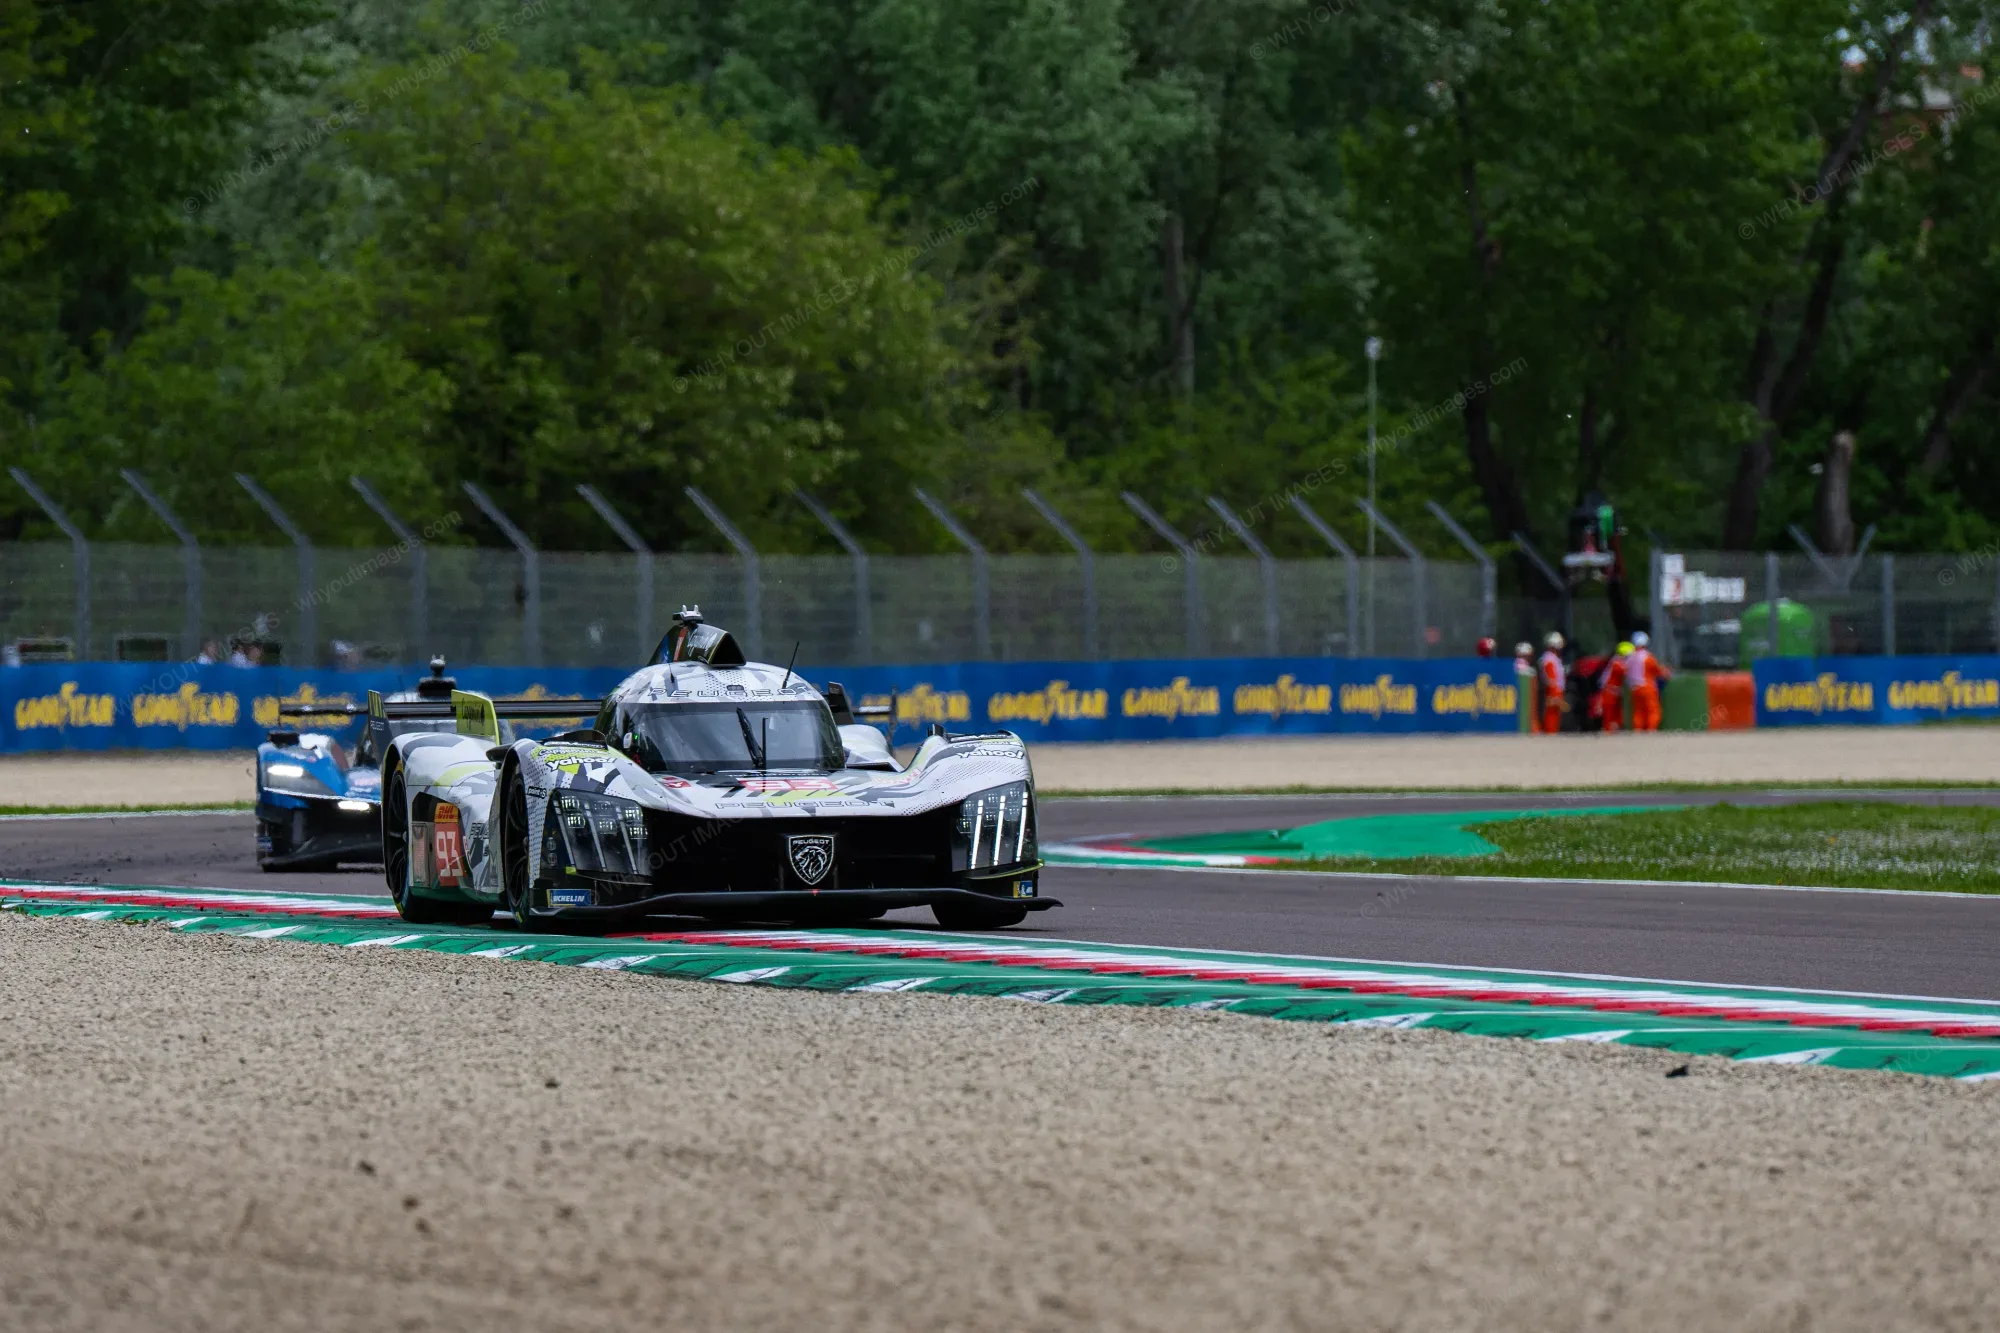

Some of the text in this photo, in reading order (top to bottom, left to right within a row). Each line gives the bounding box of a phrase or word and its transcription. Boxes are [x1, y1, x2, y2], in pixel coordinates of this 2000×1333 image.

[648, 686, 808, 697] PEUGEOT
[1765, 673, 1873, 715] GOODYEAR
[1887, 671, 2000, 711] GOODYEAR
[957, 749, 1024, 760] yahoo!
[546, 757, 617, 771] yahoo!
[745, 780, 833, 790] 93
[715, 801, 895, 810] PEUGEOT
[436, 831, 463, 877] 93
